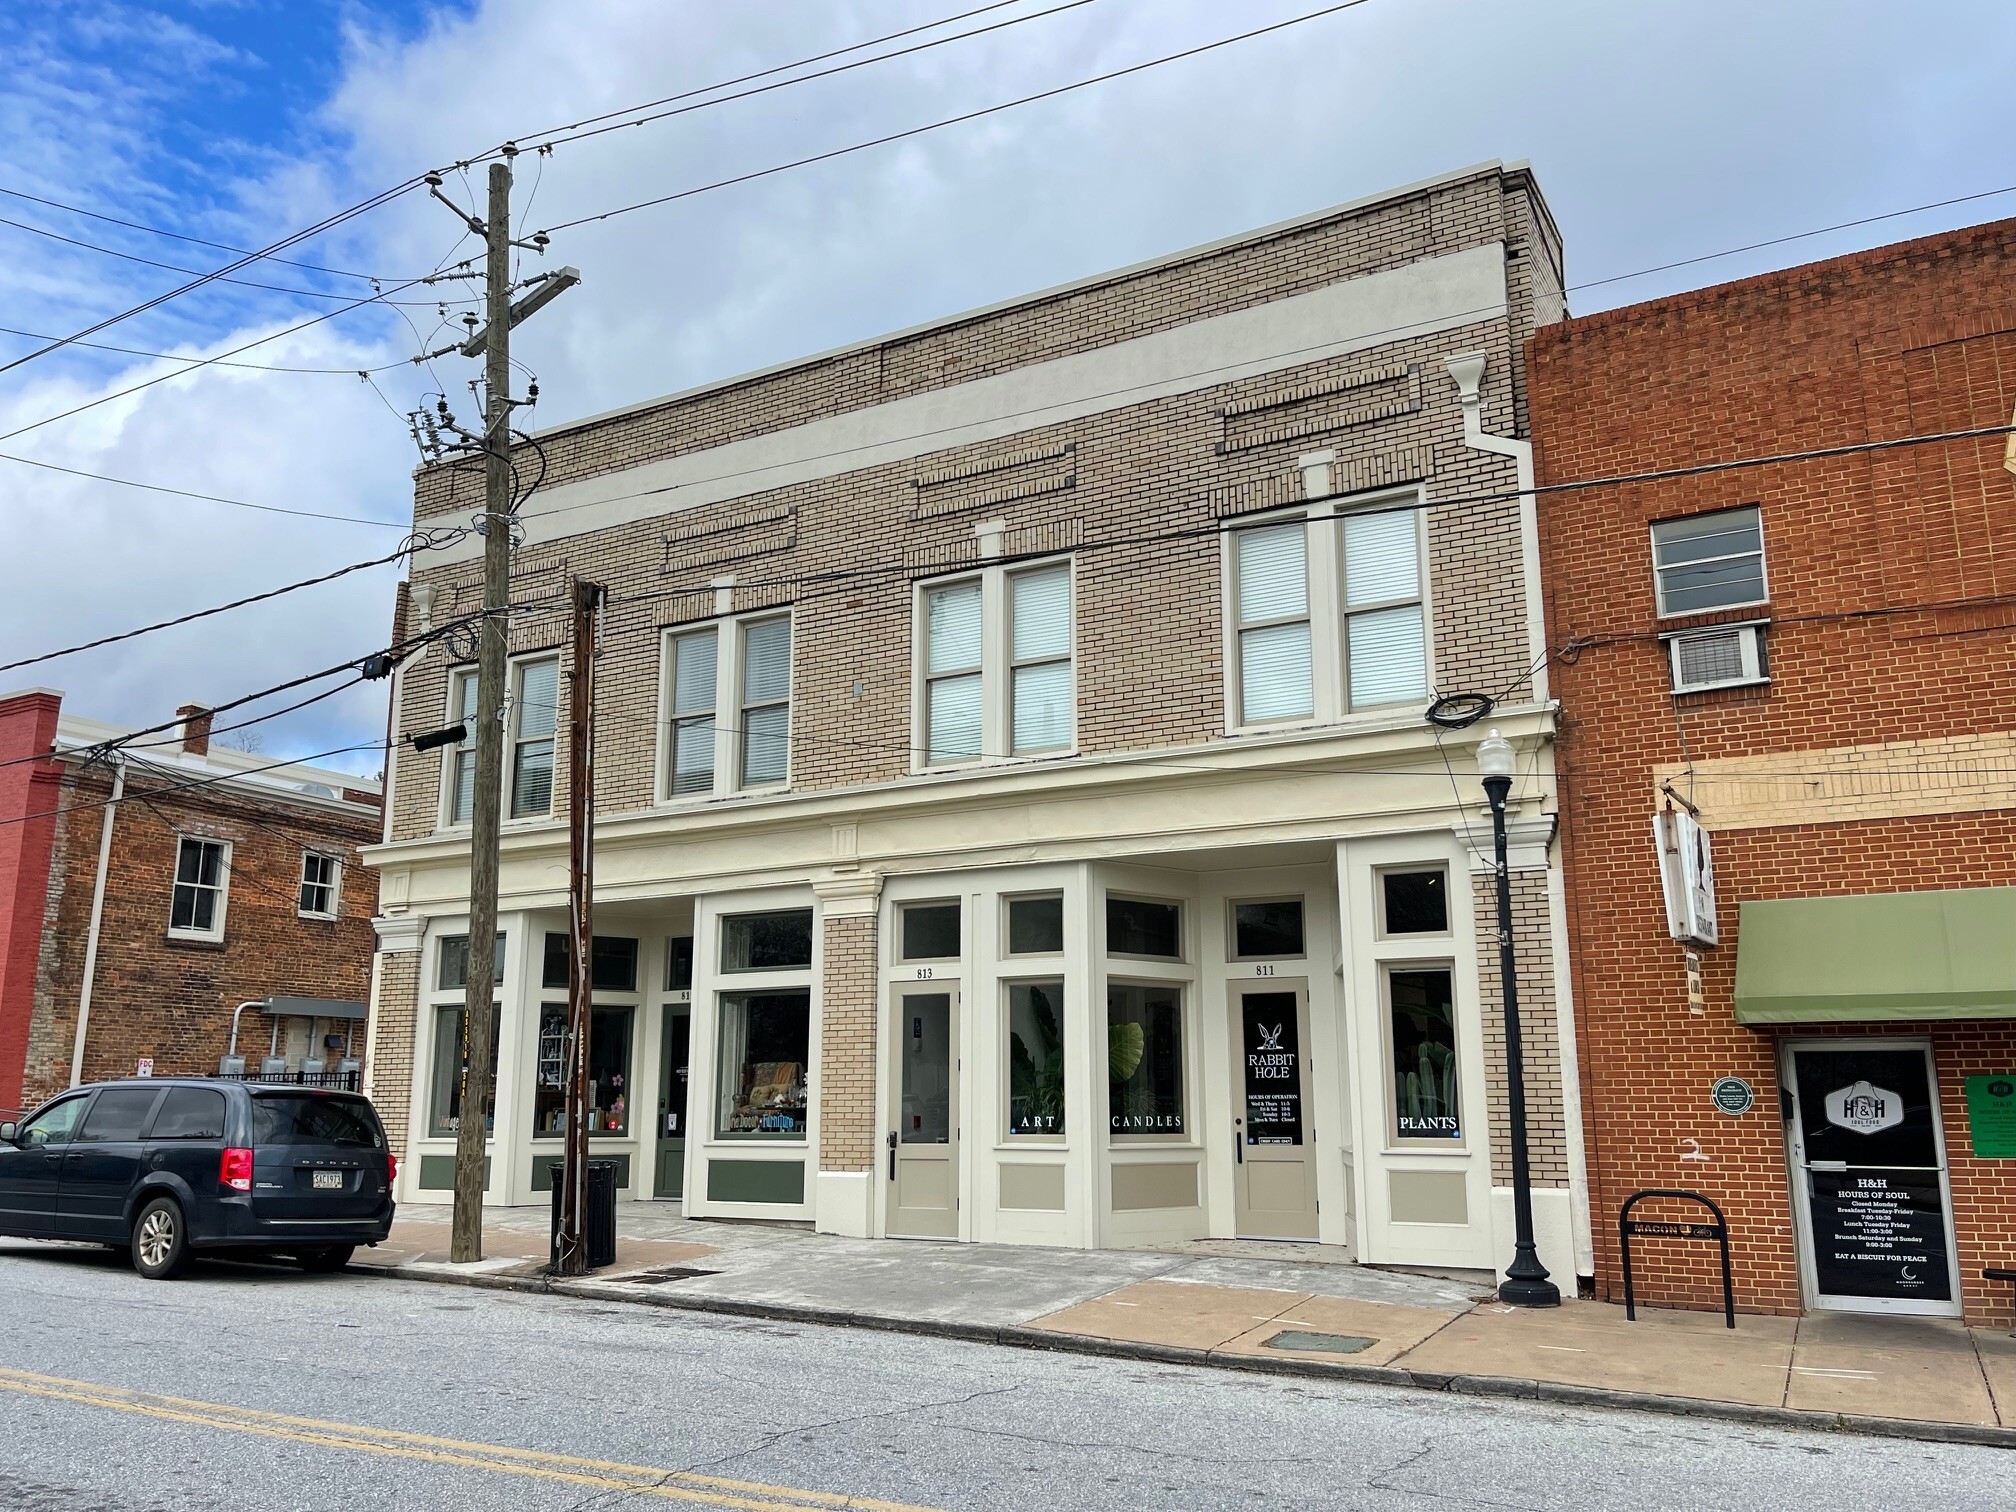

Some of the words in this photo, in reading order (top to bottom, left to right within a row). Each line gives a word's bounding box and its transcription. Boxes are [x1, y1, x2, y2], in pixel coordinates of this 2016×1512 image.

[917, 968, 933, 979] 813
[1256, 965, 1274, 976] 811
[681, 991, 690, 1000] 81
[140, 1060, 152, 1068] FDC
[1248, 1054, 1295, 1066] RABBIT
[1255, 1066, 1290, 1078] HOLE
[1021, 1116, 1055, 1127] ART
[1112, 1115, 1181, 1127] CANDLES
[1399, 1117, 1457, 1129] PLANTS
[1857, 1179, 1887, 1188] H&H
[1634, 1224, 1678, 1234] MACON
